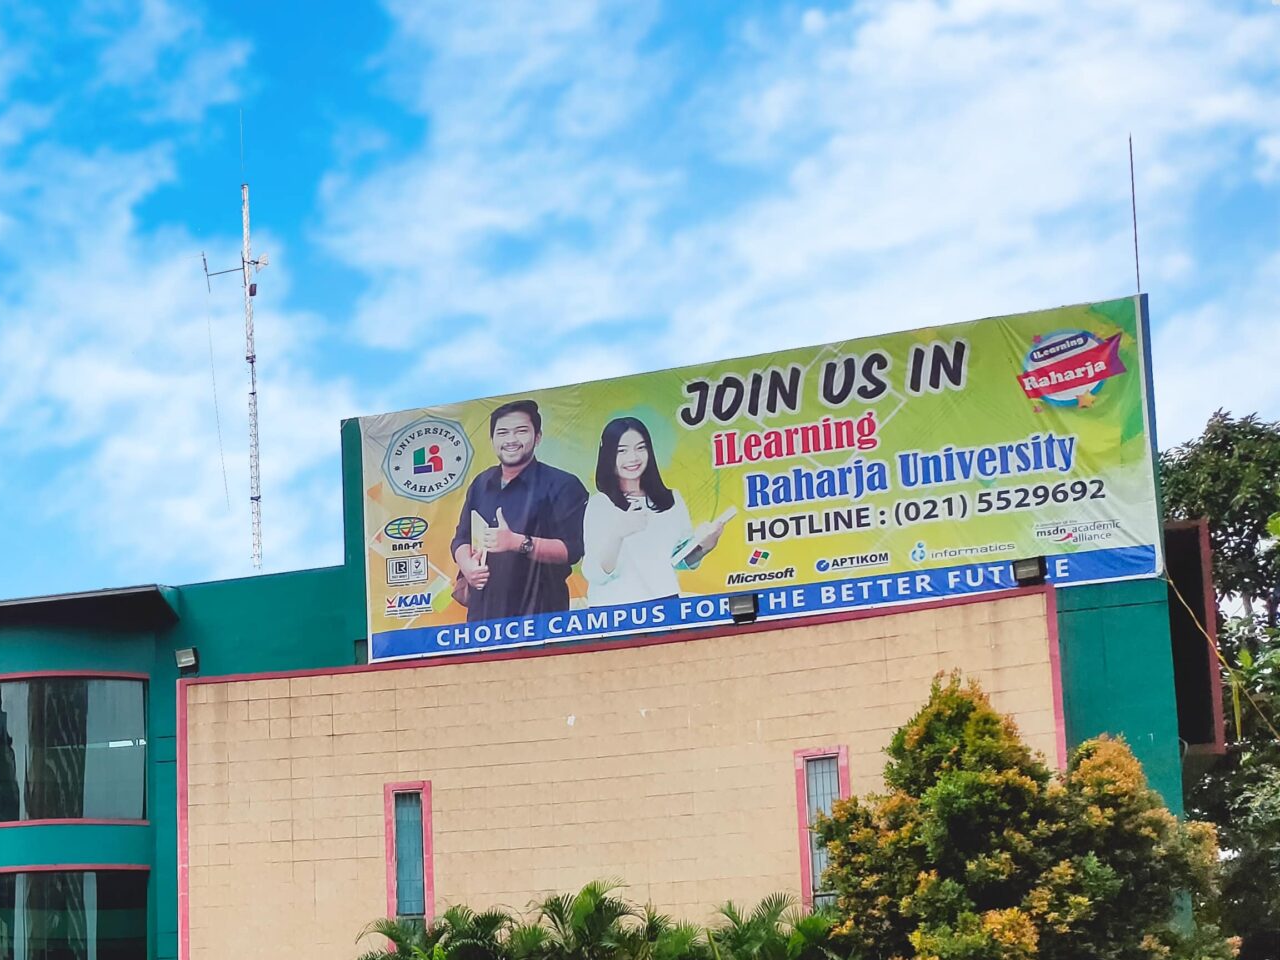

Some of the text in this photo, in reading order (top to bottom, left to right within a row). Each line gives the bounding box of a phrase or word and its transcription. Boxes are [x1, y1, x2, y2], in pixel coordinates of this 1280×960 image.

[680, 340, 966, 426] JOIN US IN
[1022, 361, 1107, 391] Raharja
[395, 427, 461, 457] UNIVERSITAS
[713, 411, 878, 467] iLearning
[746, 432, 1075, 508] Raharja University
[403, 471, 457, 493] RAHARJA
[746, 507, 871, 542] HOTLINE
[893, 493, 968, 526] (021)
[977, 479, 1106, 514] 5529692
[1036, 526, 1066, 537] msdn
[1071, 520, 1121, 533] academic
[1072, 531, 1112, 543] alliance
[391, 541, 424, 551] BAN-PT
[931, 543, 1016, 559] informatics
[831, 552, 889, 568] APTIKOM
[727, 567, 795, 585] Microsoft
[397, 592, 432, 608] KAN
[436, 558, 1070, 647] CHOICE CAMPUS FOR HE BETTER FUTE
